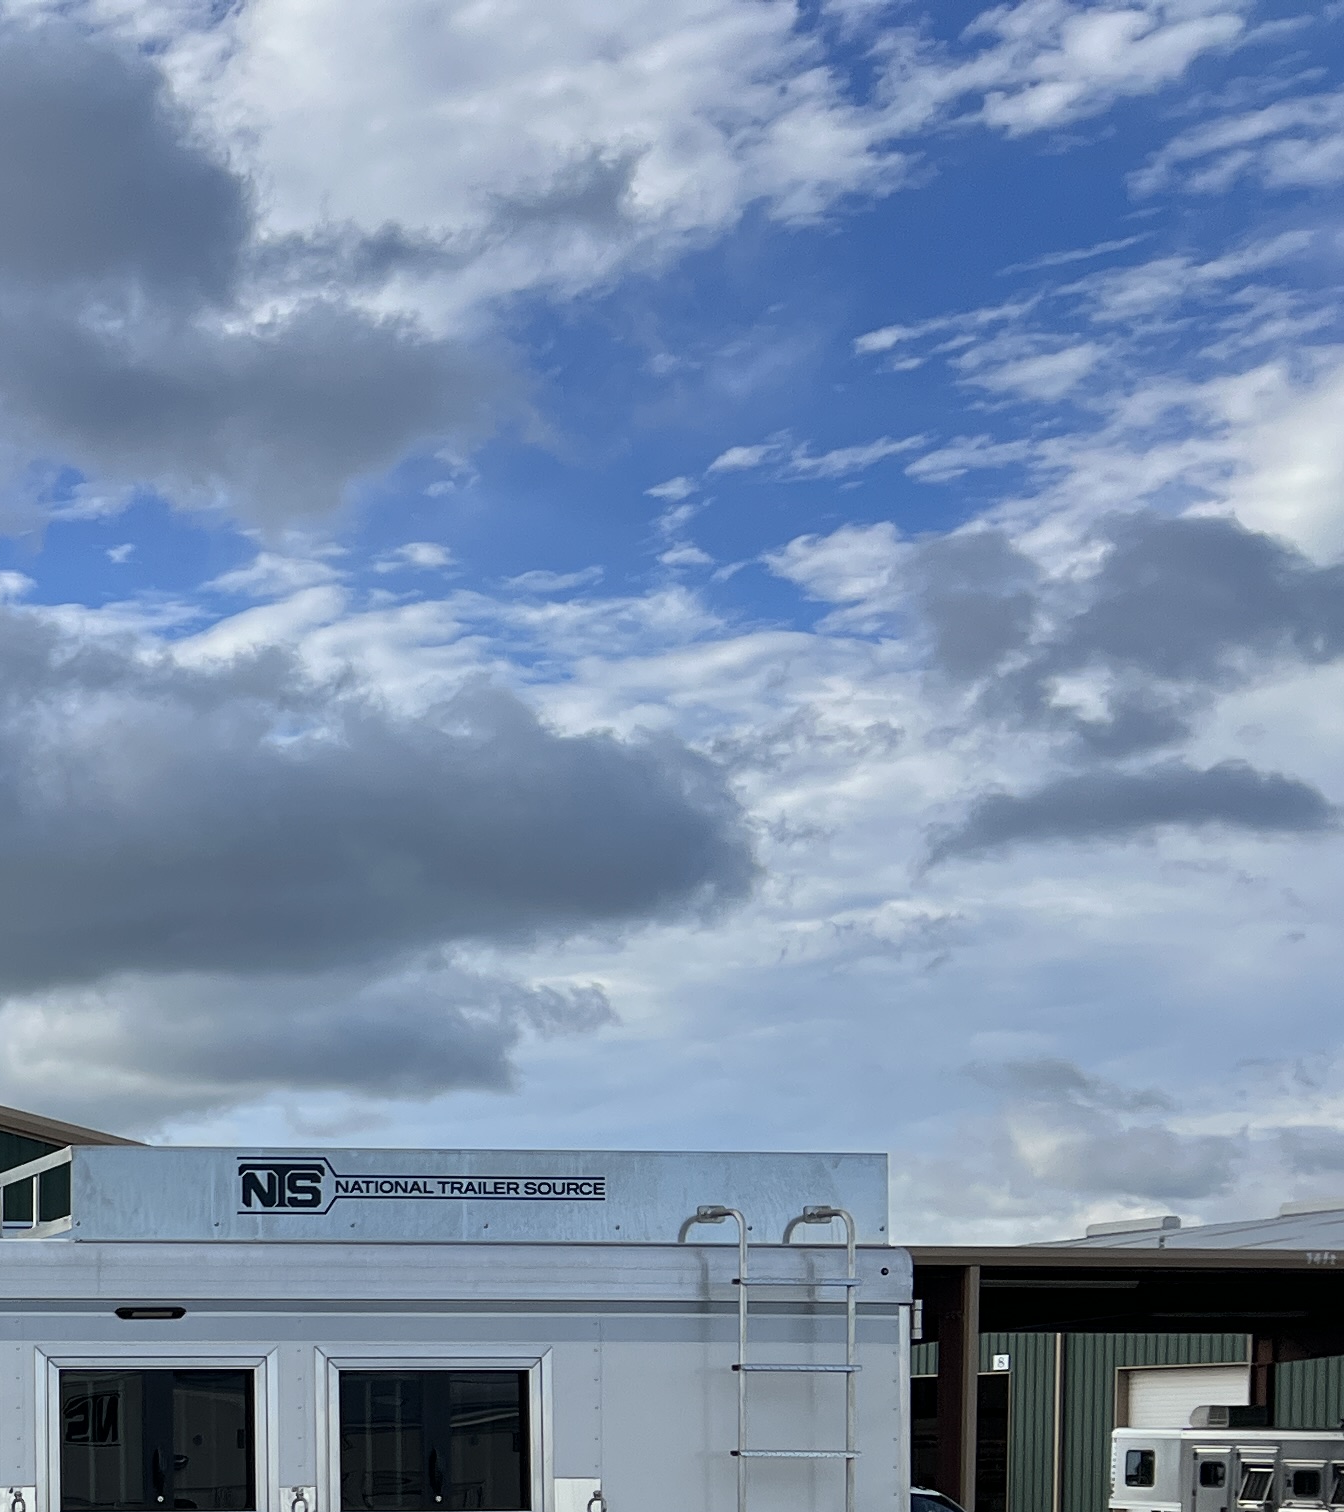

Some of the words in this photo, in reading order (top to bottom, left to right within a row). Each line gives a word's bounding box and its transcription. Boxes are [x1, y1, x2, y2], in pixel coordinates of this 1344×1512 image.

[238, 1163, 326, 1208] NTS
[334, 1179, 435, 1195] NATIONAL
[437, 1180, 520, 1196] TRAILER
[523, 1181, 606, 1197] SOURCE
